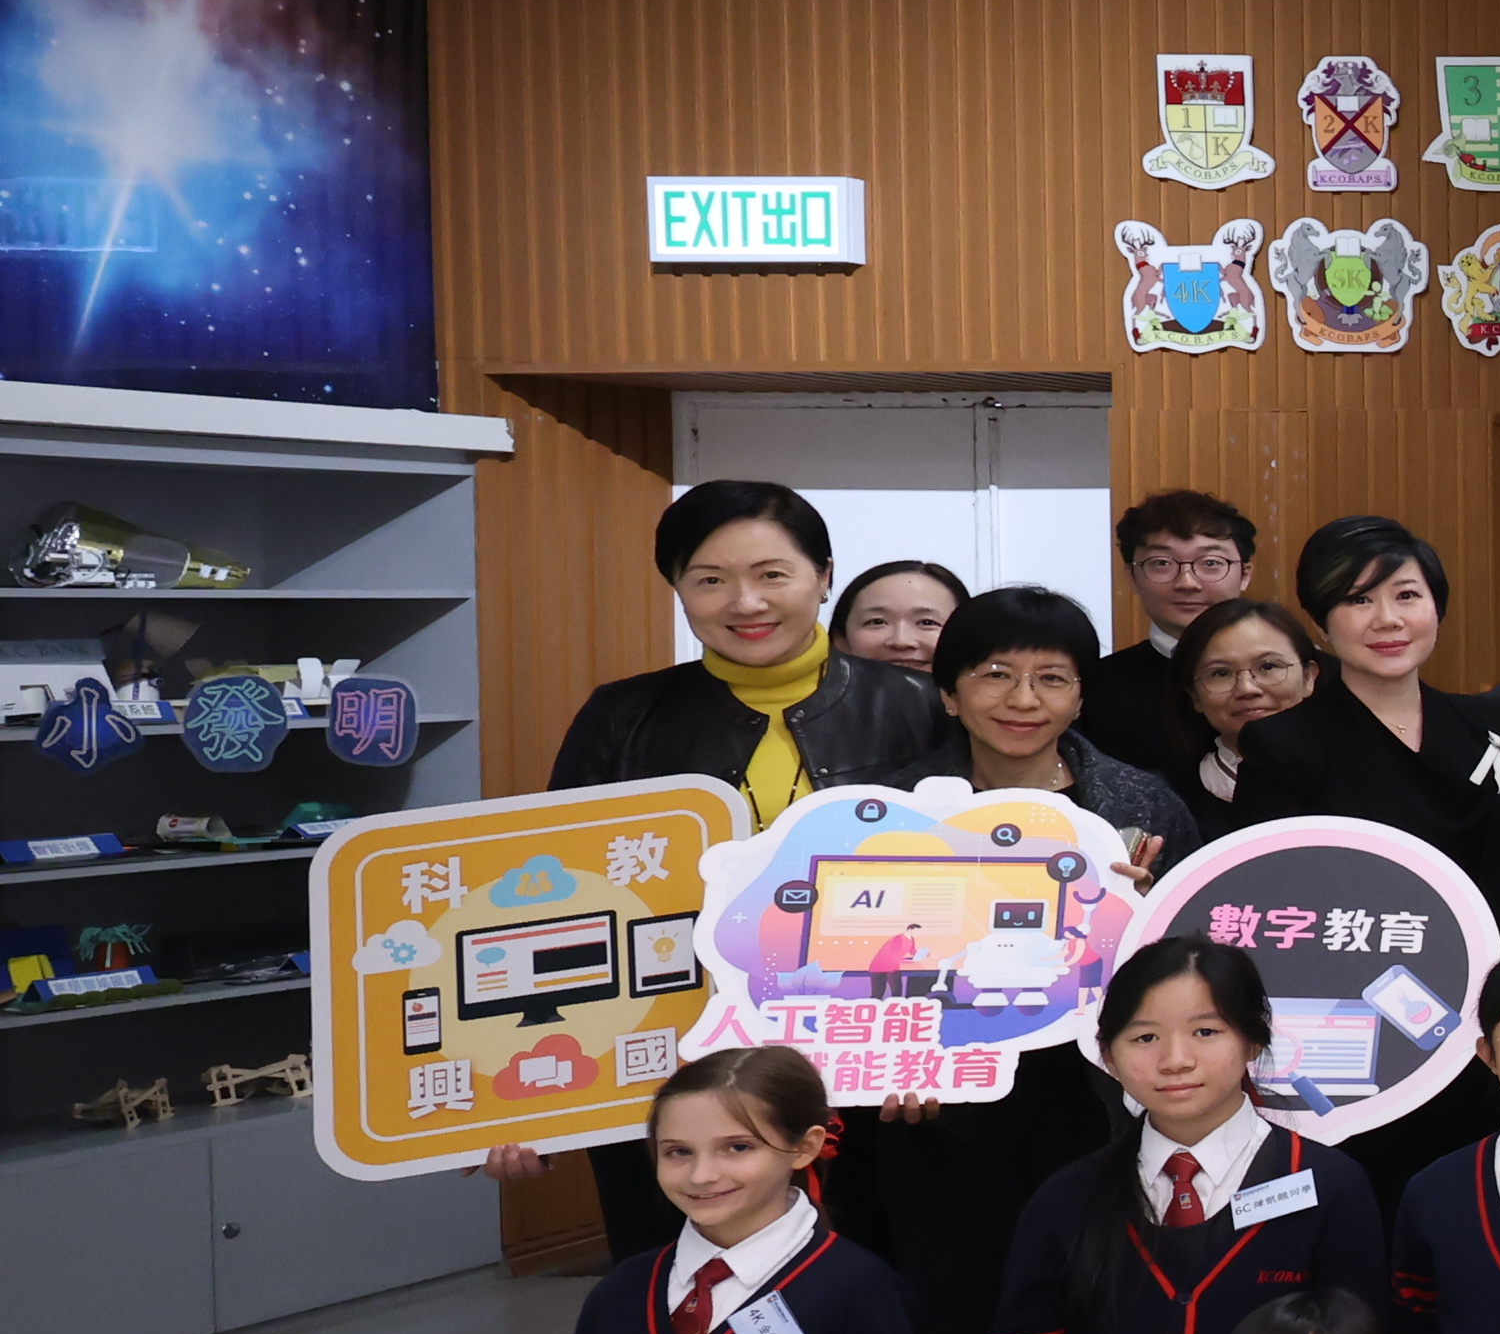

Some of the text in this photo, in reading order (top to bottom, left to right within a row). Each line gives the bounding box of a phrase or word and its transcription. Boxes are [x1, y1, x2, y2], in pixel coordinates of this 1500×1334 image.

[1463, 75, 1482, 106] 3
[1182, 107, 1191, 128] 1
[1323, 115, 1381, 134] 2 K
[1212, 136, 1231, 156] K
[664, 191, 833, 247] EXIT 出口
[1332, 268, 1366, 288] 5K
[1172, 281, 1212, 303] 4K
[850, 889, 885, 909] AI
[1208, 903, 1429, 954] 數字教育
[699, 1002, 937, 1048] 人工智能
[812, 1048, 1002, 1093] 能教育
[1235, 1202, 1252, 1216] 6C
